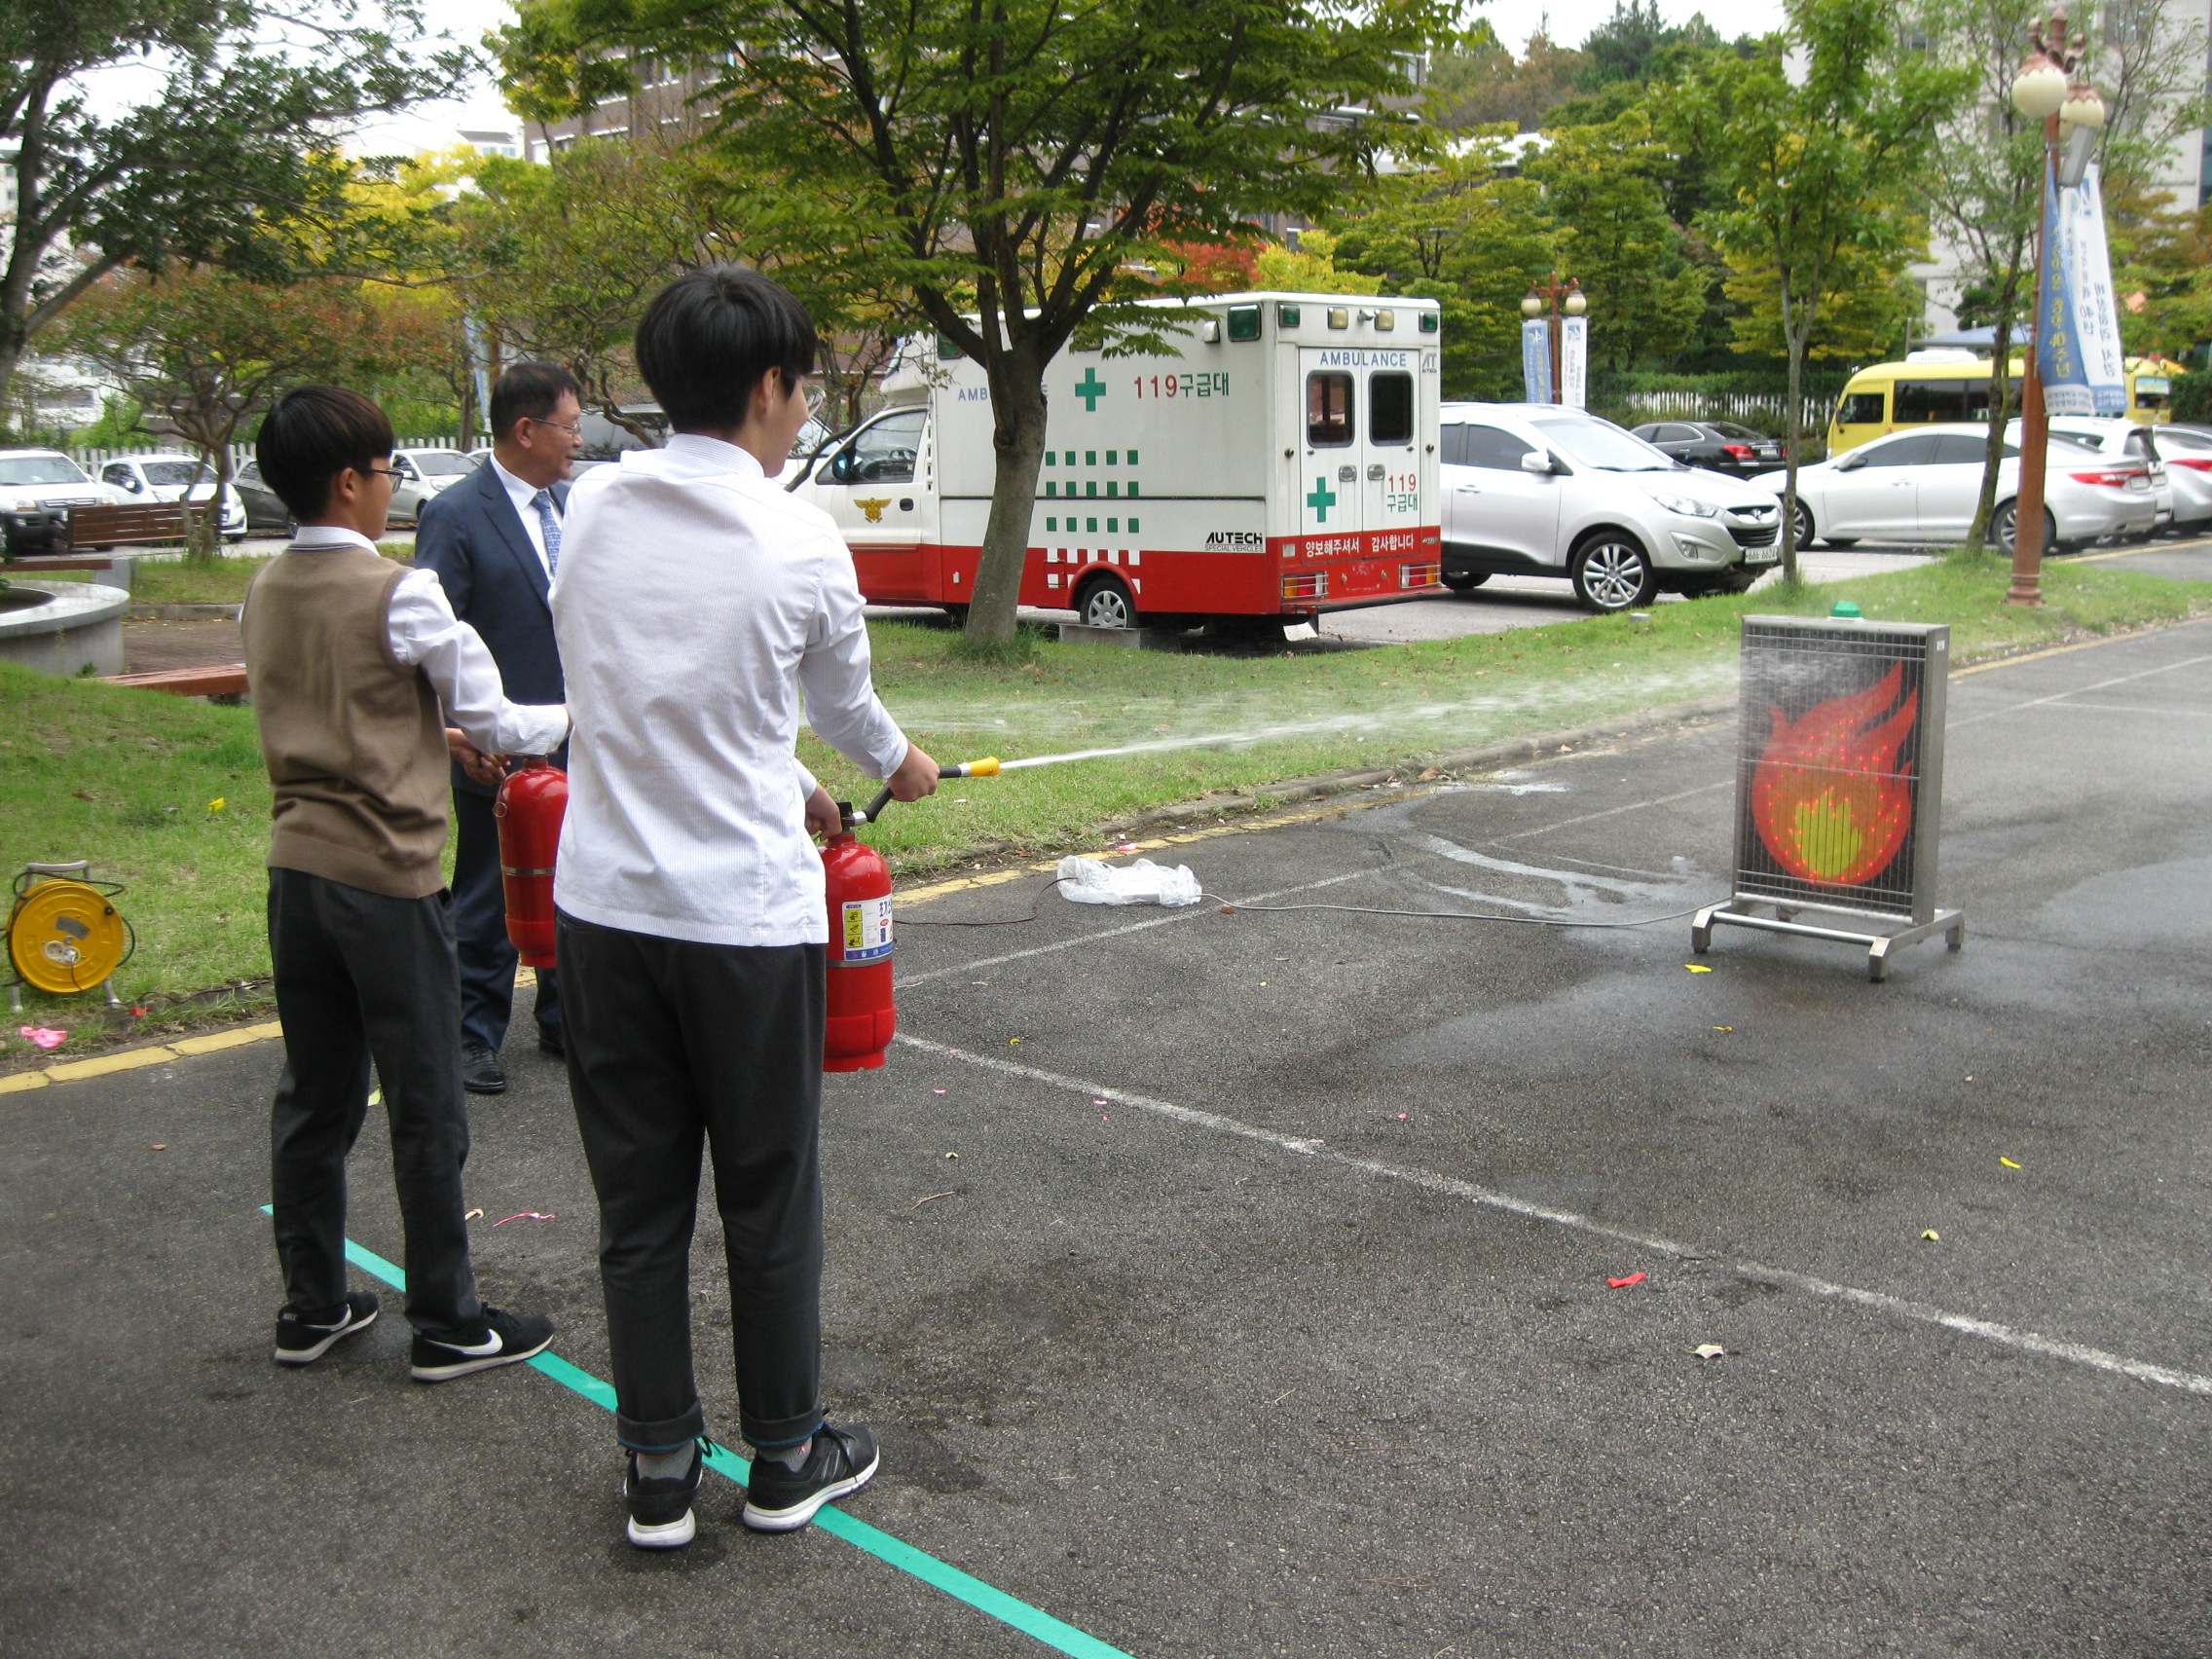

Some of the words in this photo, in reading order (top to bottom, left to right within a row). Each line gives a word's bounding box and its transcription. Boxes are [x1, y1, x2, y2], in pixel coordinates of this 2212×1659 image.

[1320, 351, 1407, 367] AMBULANCE
[1388, 473, 1417, 493] 119
[1387, 493, 1418, 513] 구급대
[1206, 532, 1263, 544] AUTECH
[1306, 536, 1360, 558] 양보해주셔서
[1371, 534, 1415, 553] 감사합니다
